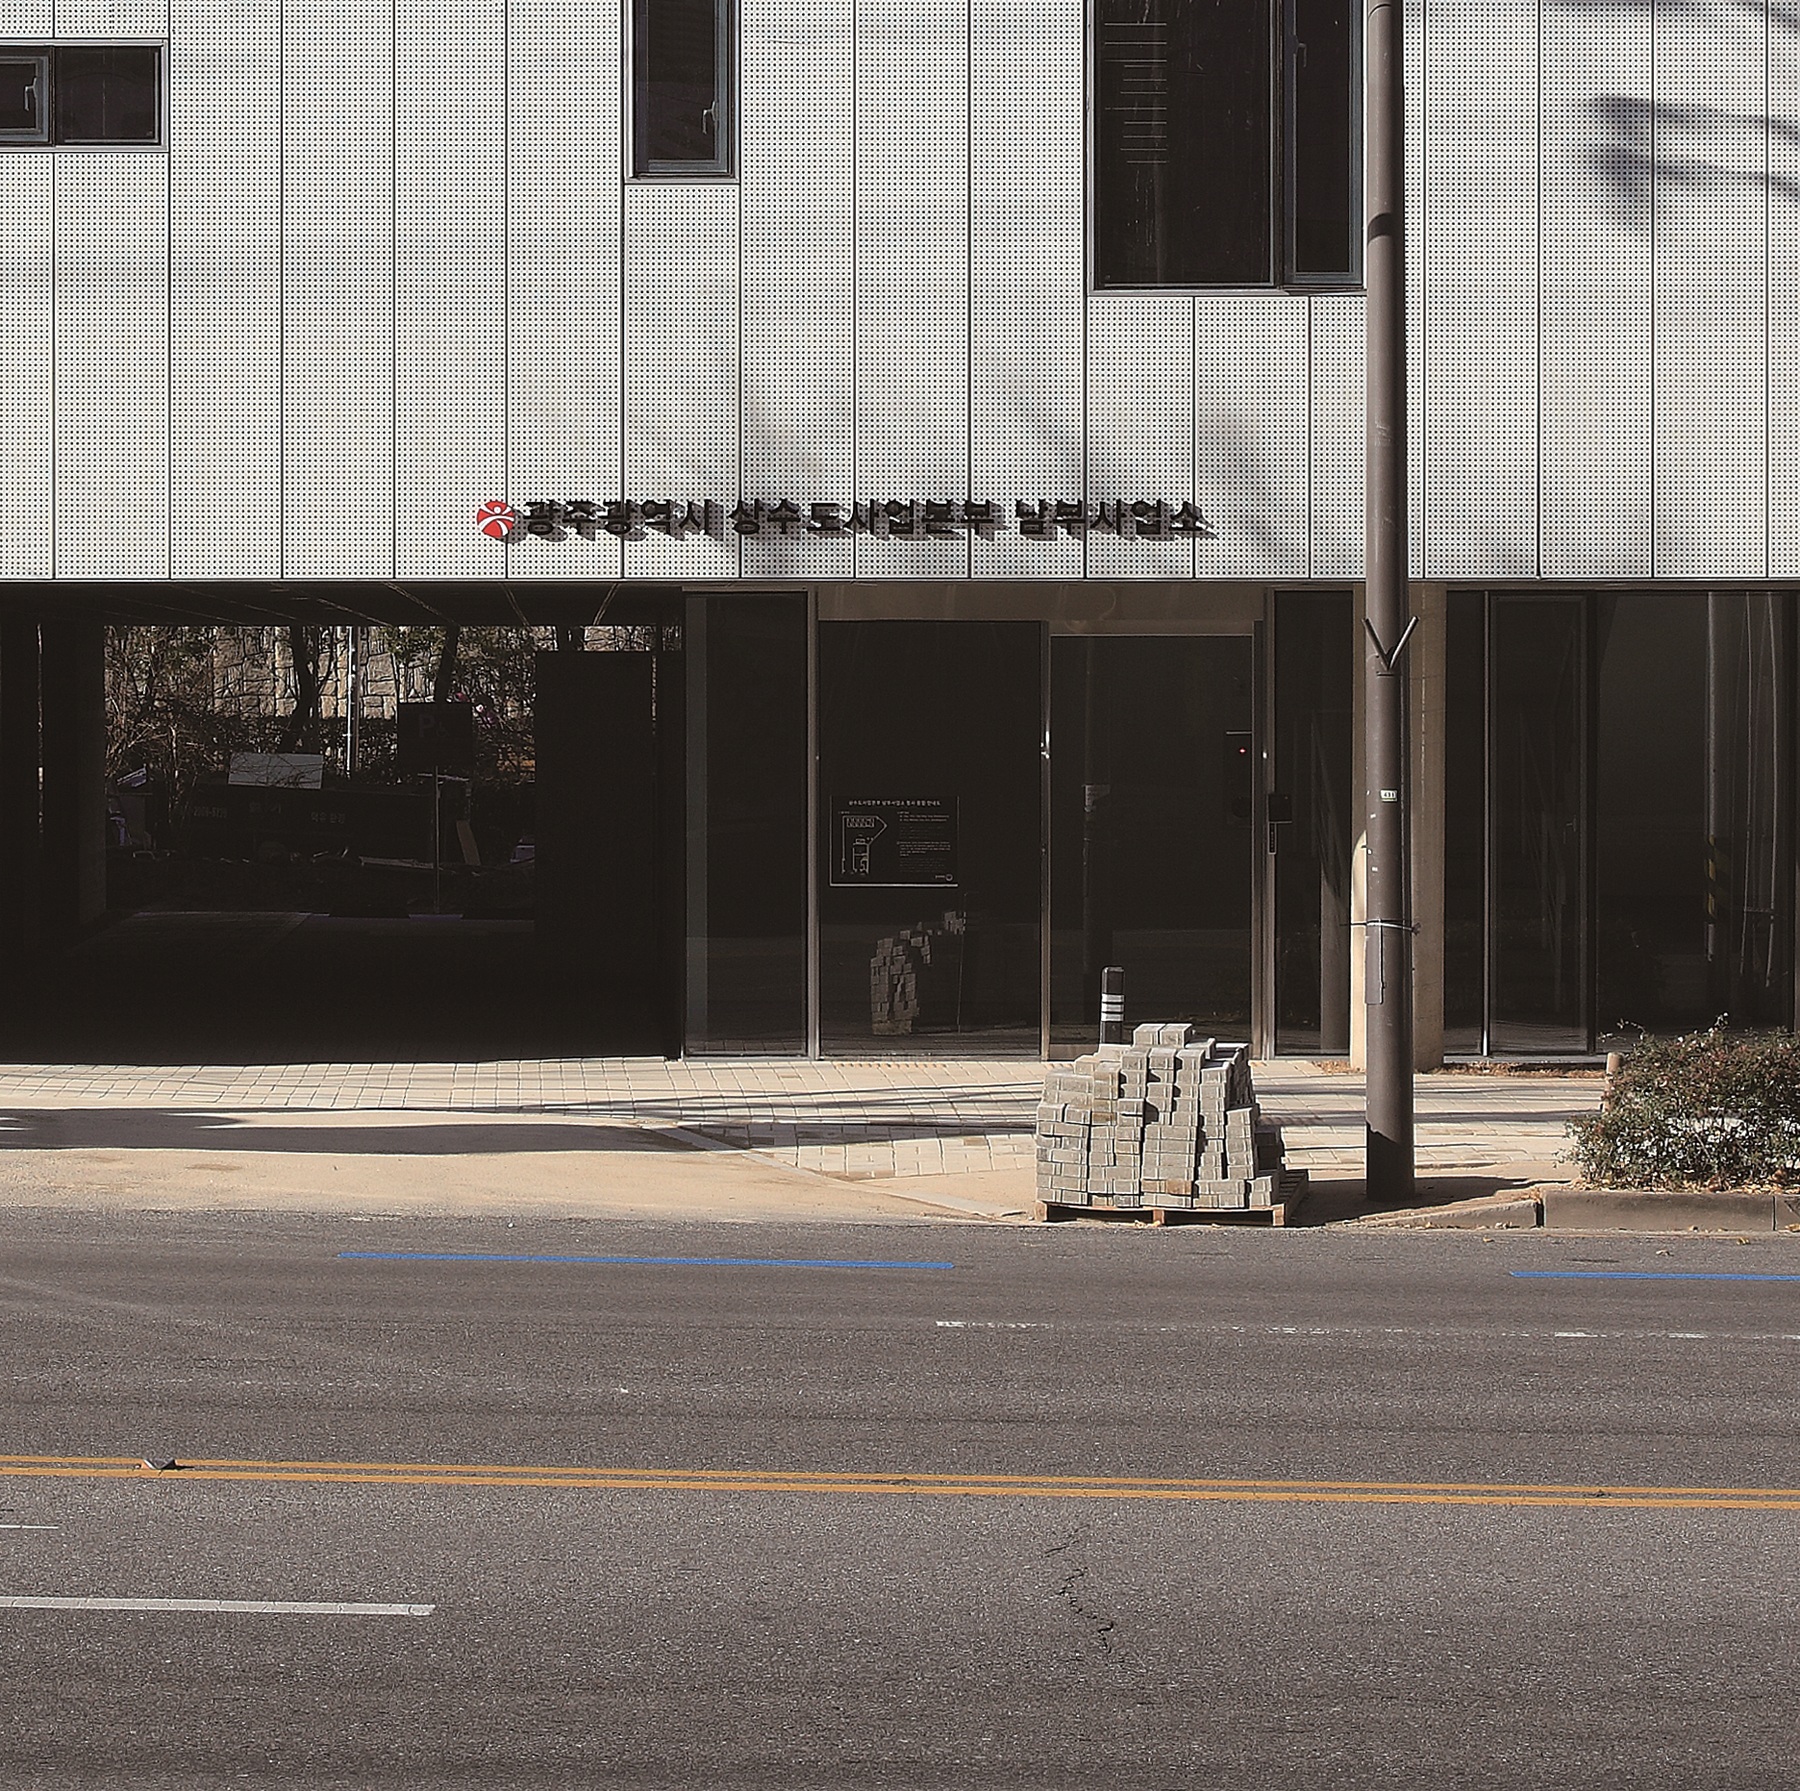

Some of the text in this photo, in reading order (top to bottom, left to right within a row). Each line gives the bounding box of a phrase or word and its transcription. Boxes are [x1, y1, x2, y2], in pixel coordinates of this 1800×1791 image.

[525, 498, 1203, 536] 광주광역시 상수도사업본부 남부사업소
